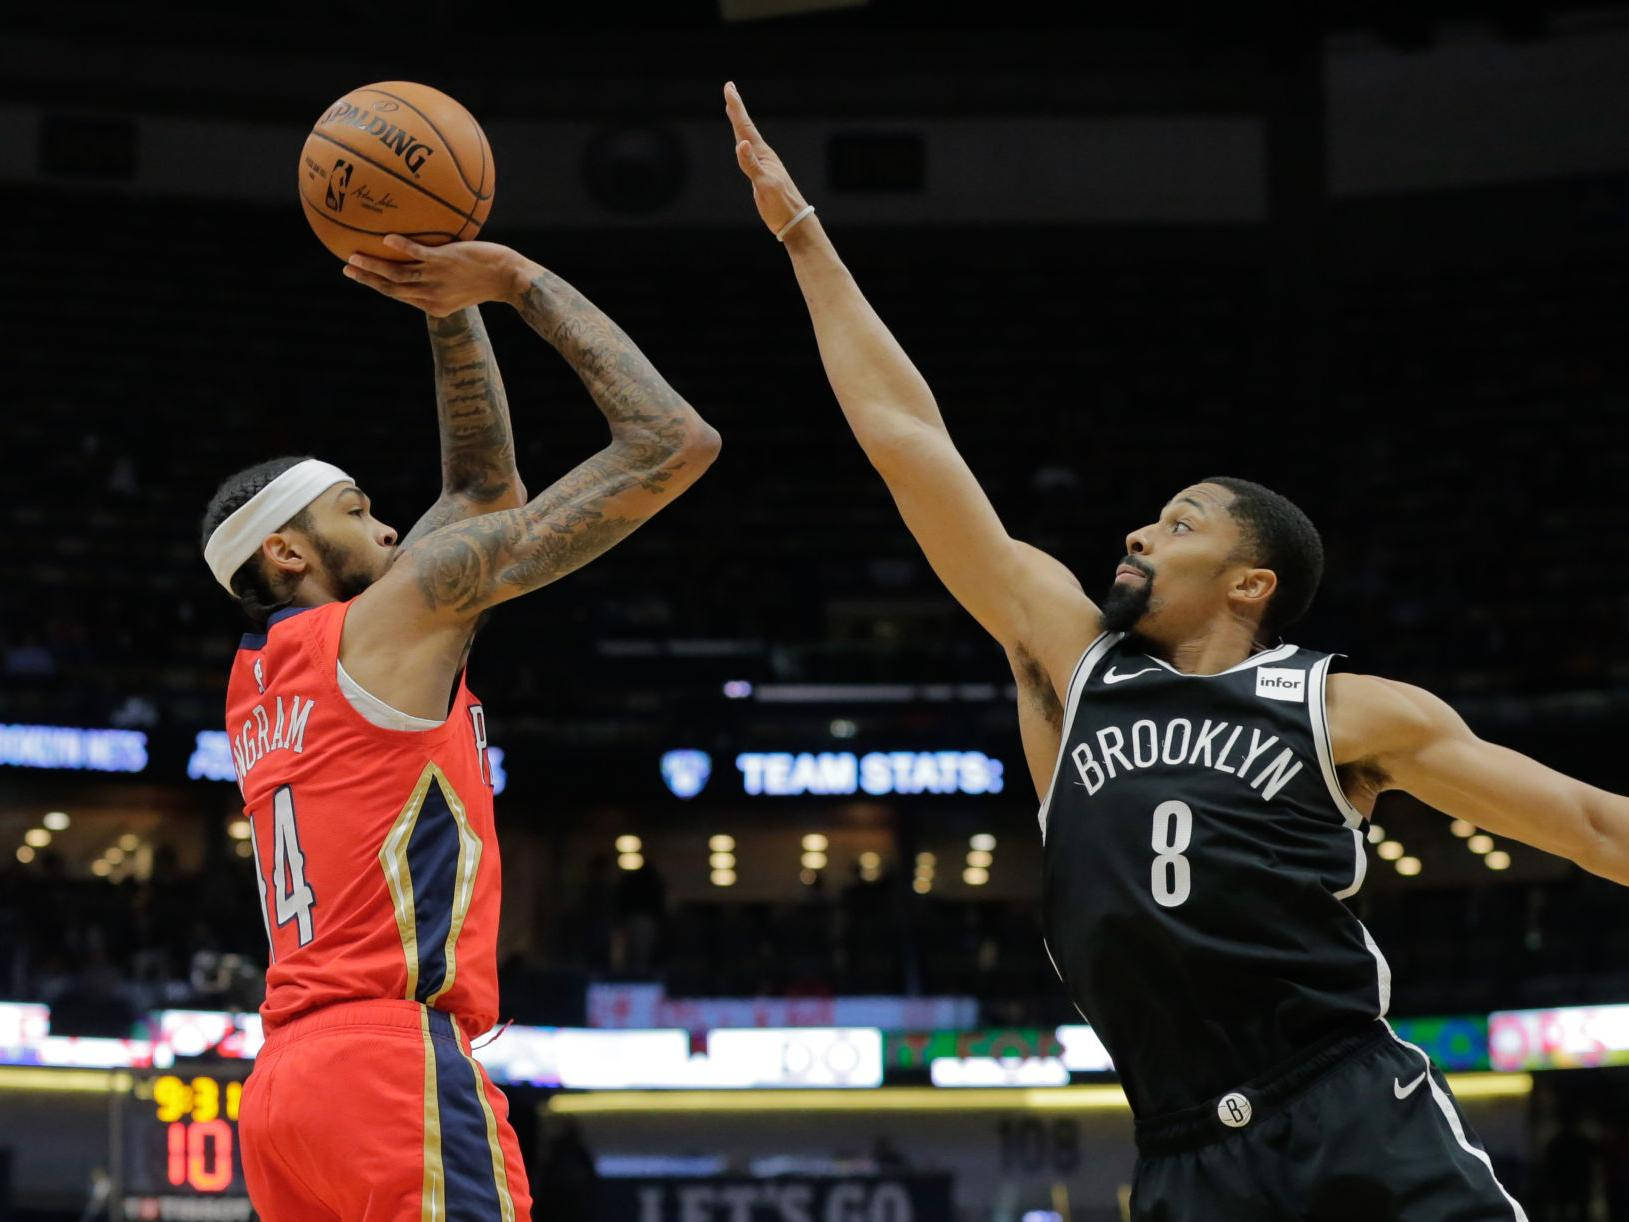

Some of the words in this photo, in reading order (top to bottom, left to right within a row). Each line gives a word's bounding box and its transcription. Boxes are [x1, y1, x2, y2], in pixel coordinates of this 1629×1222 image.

[1260, 676, 1301, 689] infor
[233, 695, 315, 803] NGRAM
[736, 752, 858, 795] TEAM
[1071, 718, 1303, 801] BROOKLYN
[1151, 800, 1193, 907] 8
[168, 1119, 232, 1191] 10
